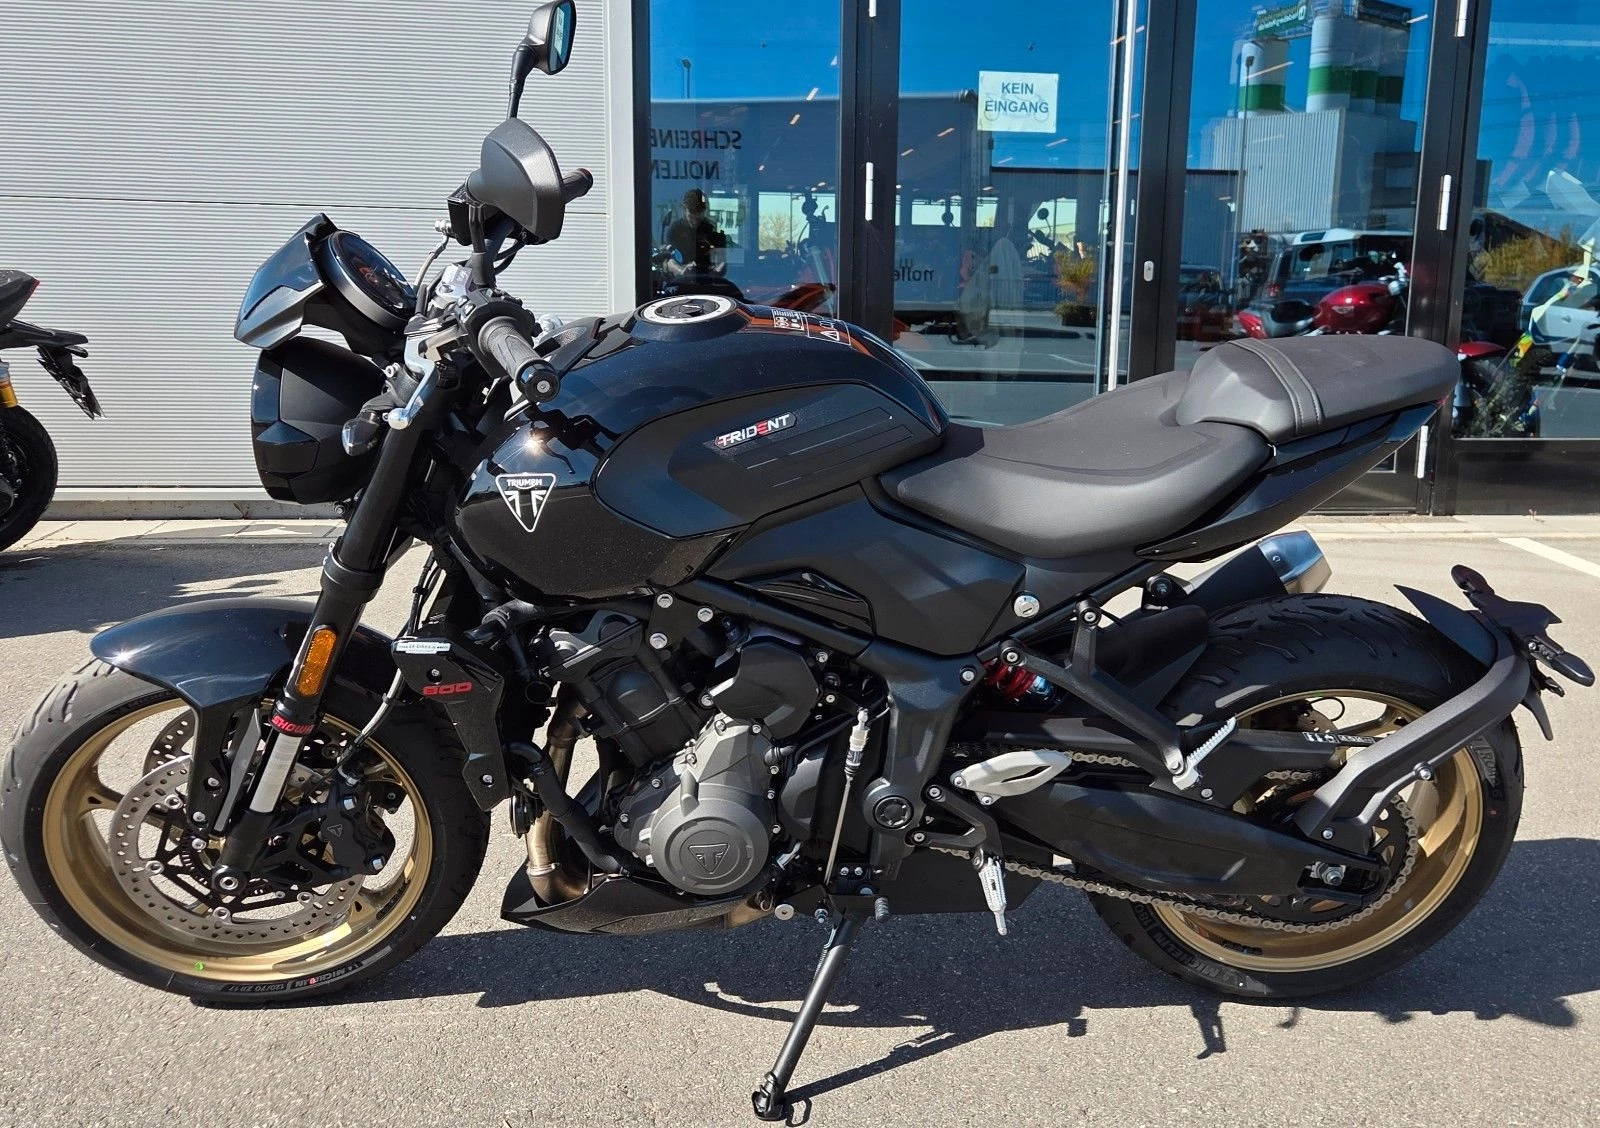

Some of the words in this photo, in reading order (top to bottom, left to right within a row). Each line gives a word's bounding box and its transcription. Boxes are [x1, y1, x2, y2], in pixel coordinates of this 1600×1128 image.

[1002, 82, 1034, 95] KEIN
[985, 100, 1049, 113] EINGANG
[718, 413, 790, 447] TRIDENT
[506, 478, 543, 487] TRIUMPH
